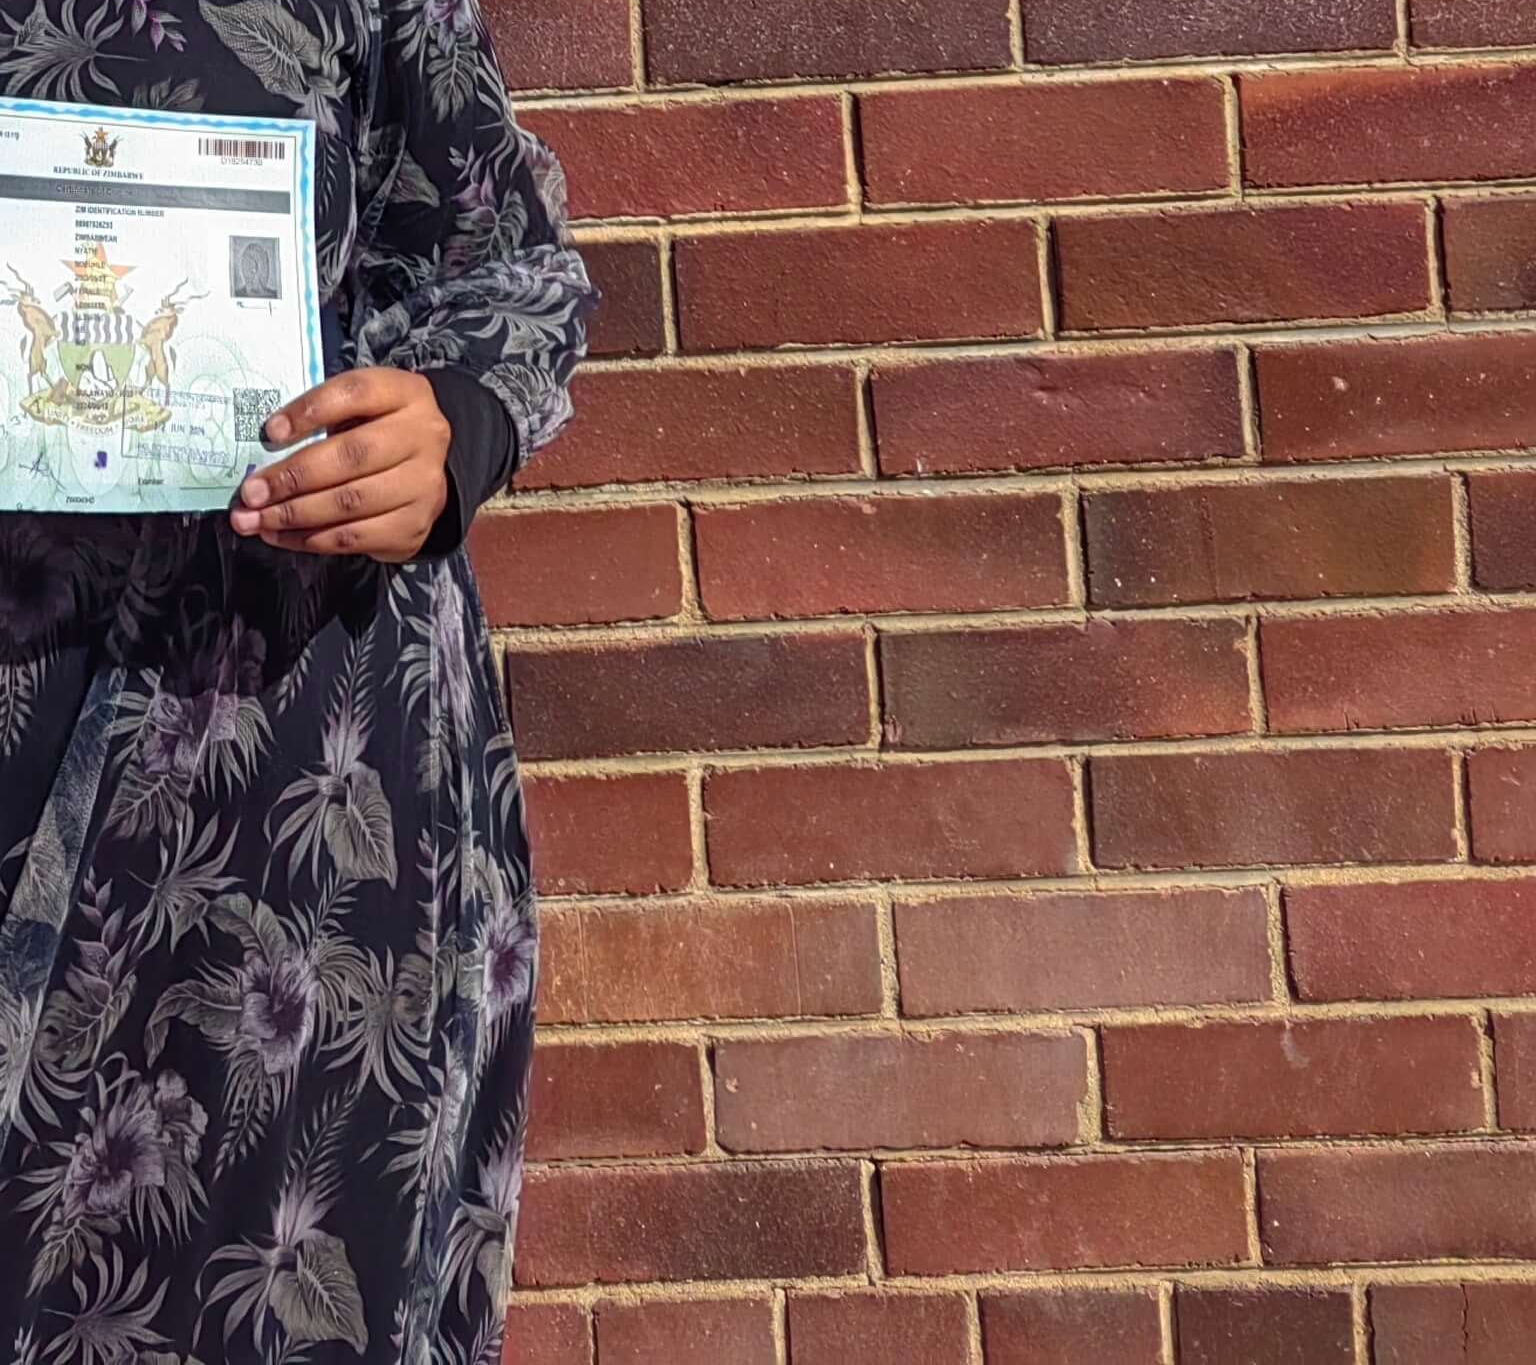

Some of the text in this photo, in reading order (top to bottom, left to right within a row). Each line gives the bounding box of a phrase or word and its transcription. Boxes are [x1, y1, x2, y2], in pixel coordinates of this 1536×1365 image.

[53, 165, 144, 181] REPUBLIC OF ZIMBABWE
[87, 206, 136, 216] IDENTIFICATION
